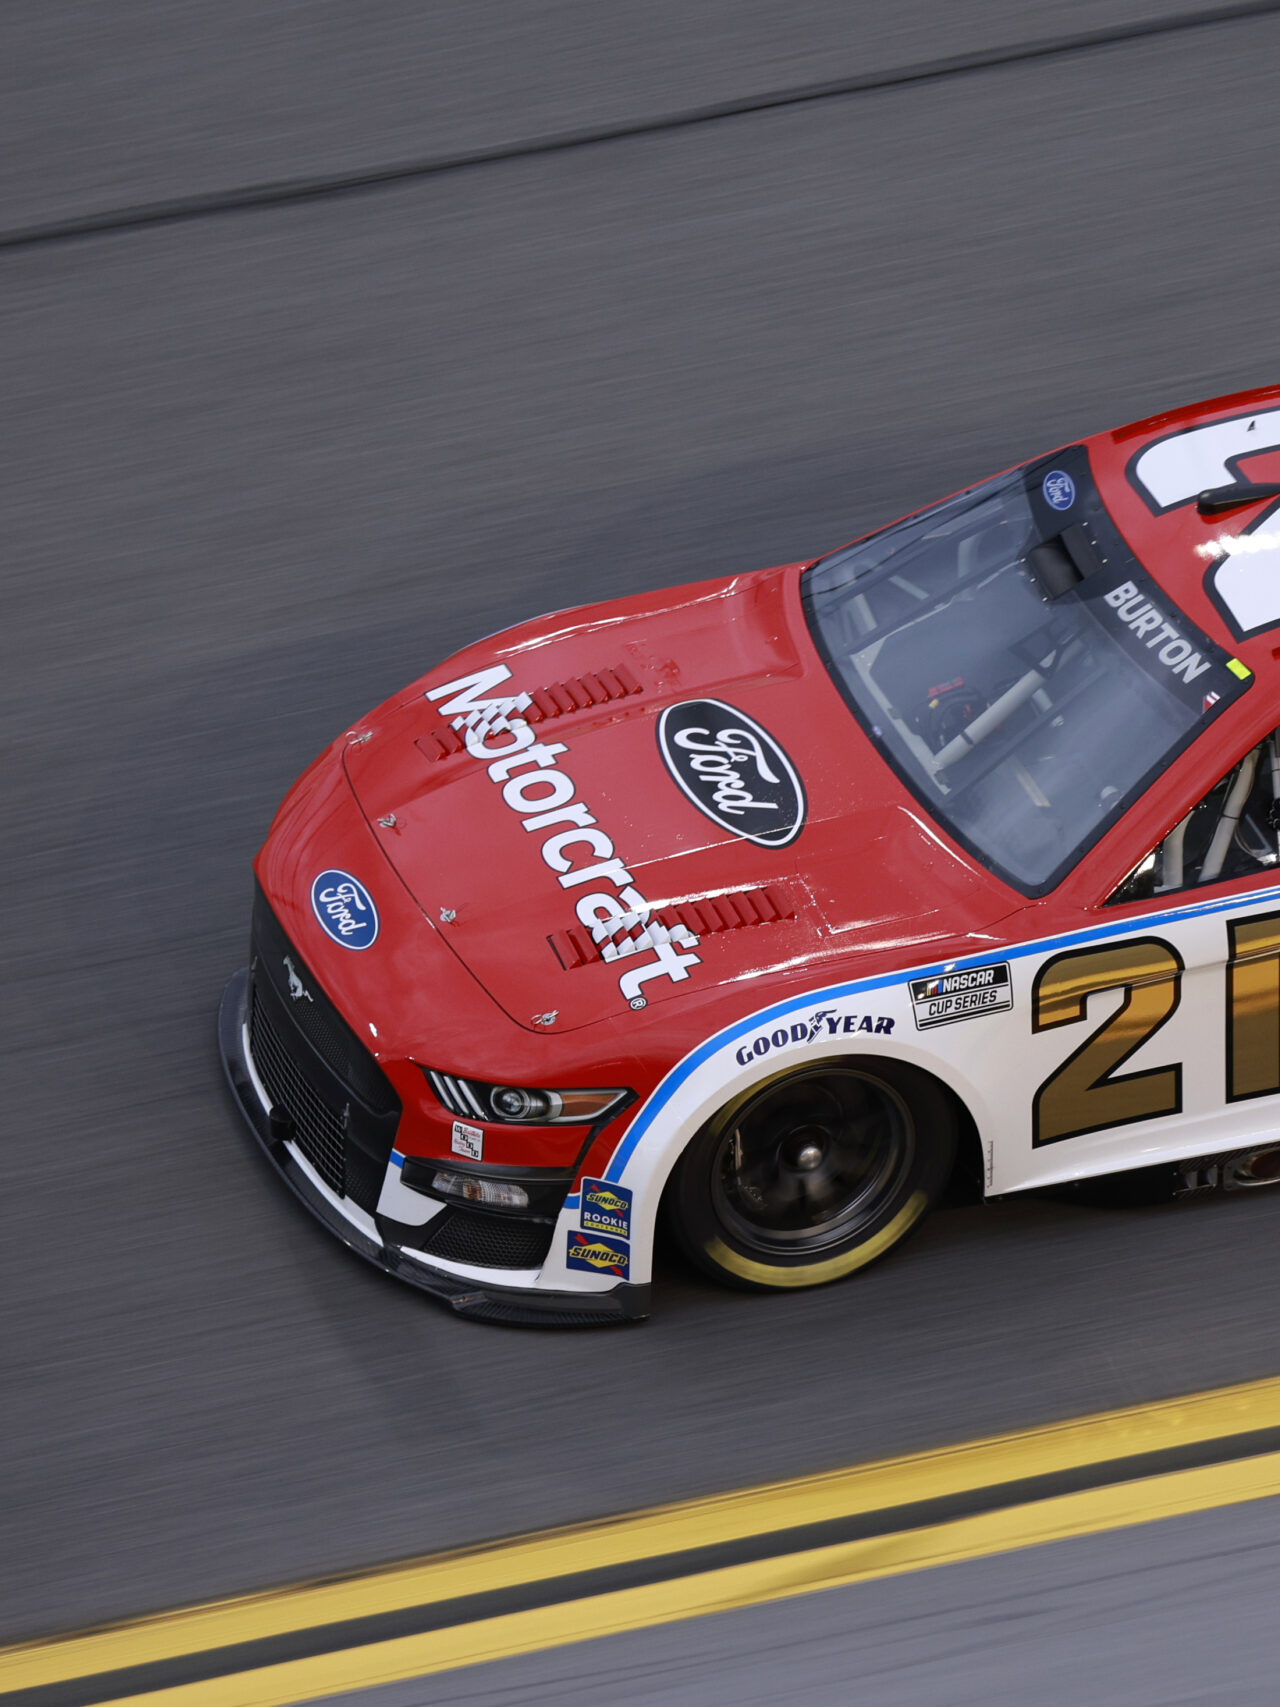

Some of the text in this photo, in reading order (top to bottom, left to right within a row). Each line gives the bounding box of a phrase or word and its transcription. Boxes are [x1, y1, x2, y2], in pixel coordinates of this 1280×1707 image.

[1047, 477, 1071, 504] Ford
[1103, 580, 1212, 684] BURTON
[674, 727, 780, 815] Ford
[425, 663, 702, 1000] Motorcraft
[319, 883, 367, 935] Ford
[943, 969, 994, 992] NASCAR
[929, 990, 997, 1016] CUP SERIES
[736, 1013, 895, 1066] GOODYEAR
[587, 1192, 627, 1210] SUNOCO
[584, 1212, 628, 1229] ROOKIE
[571, 1247, 626, 1265] SUNOCO
